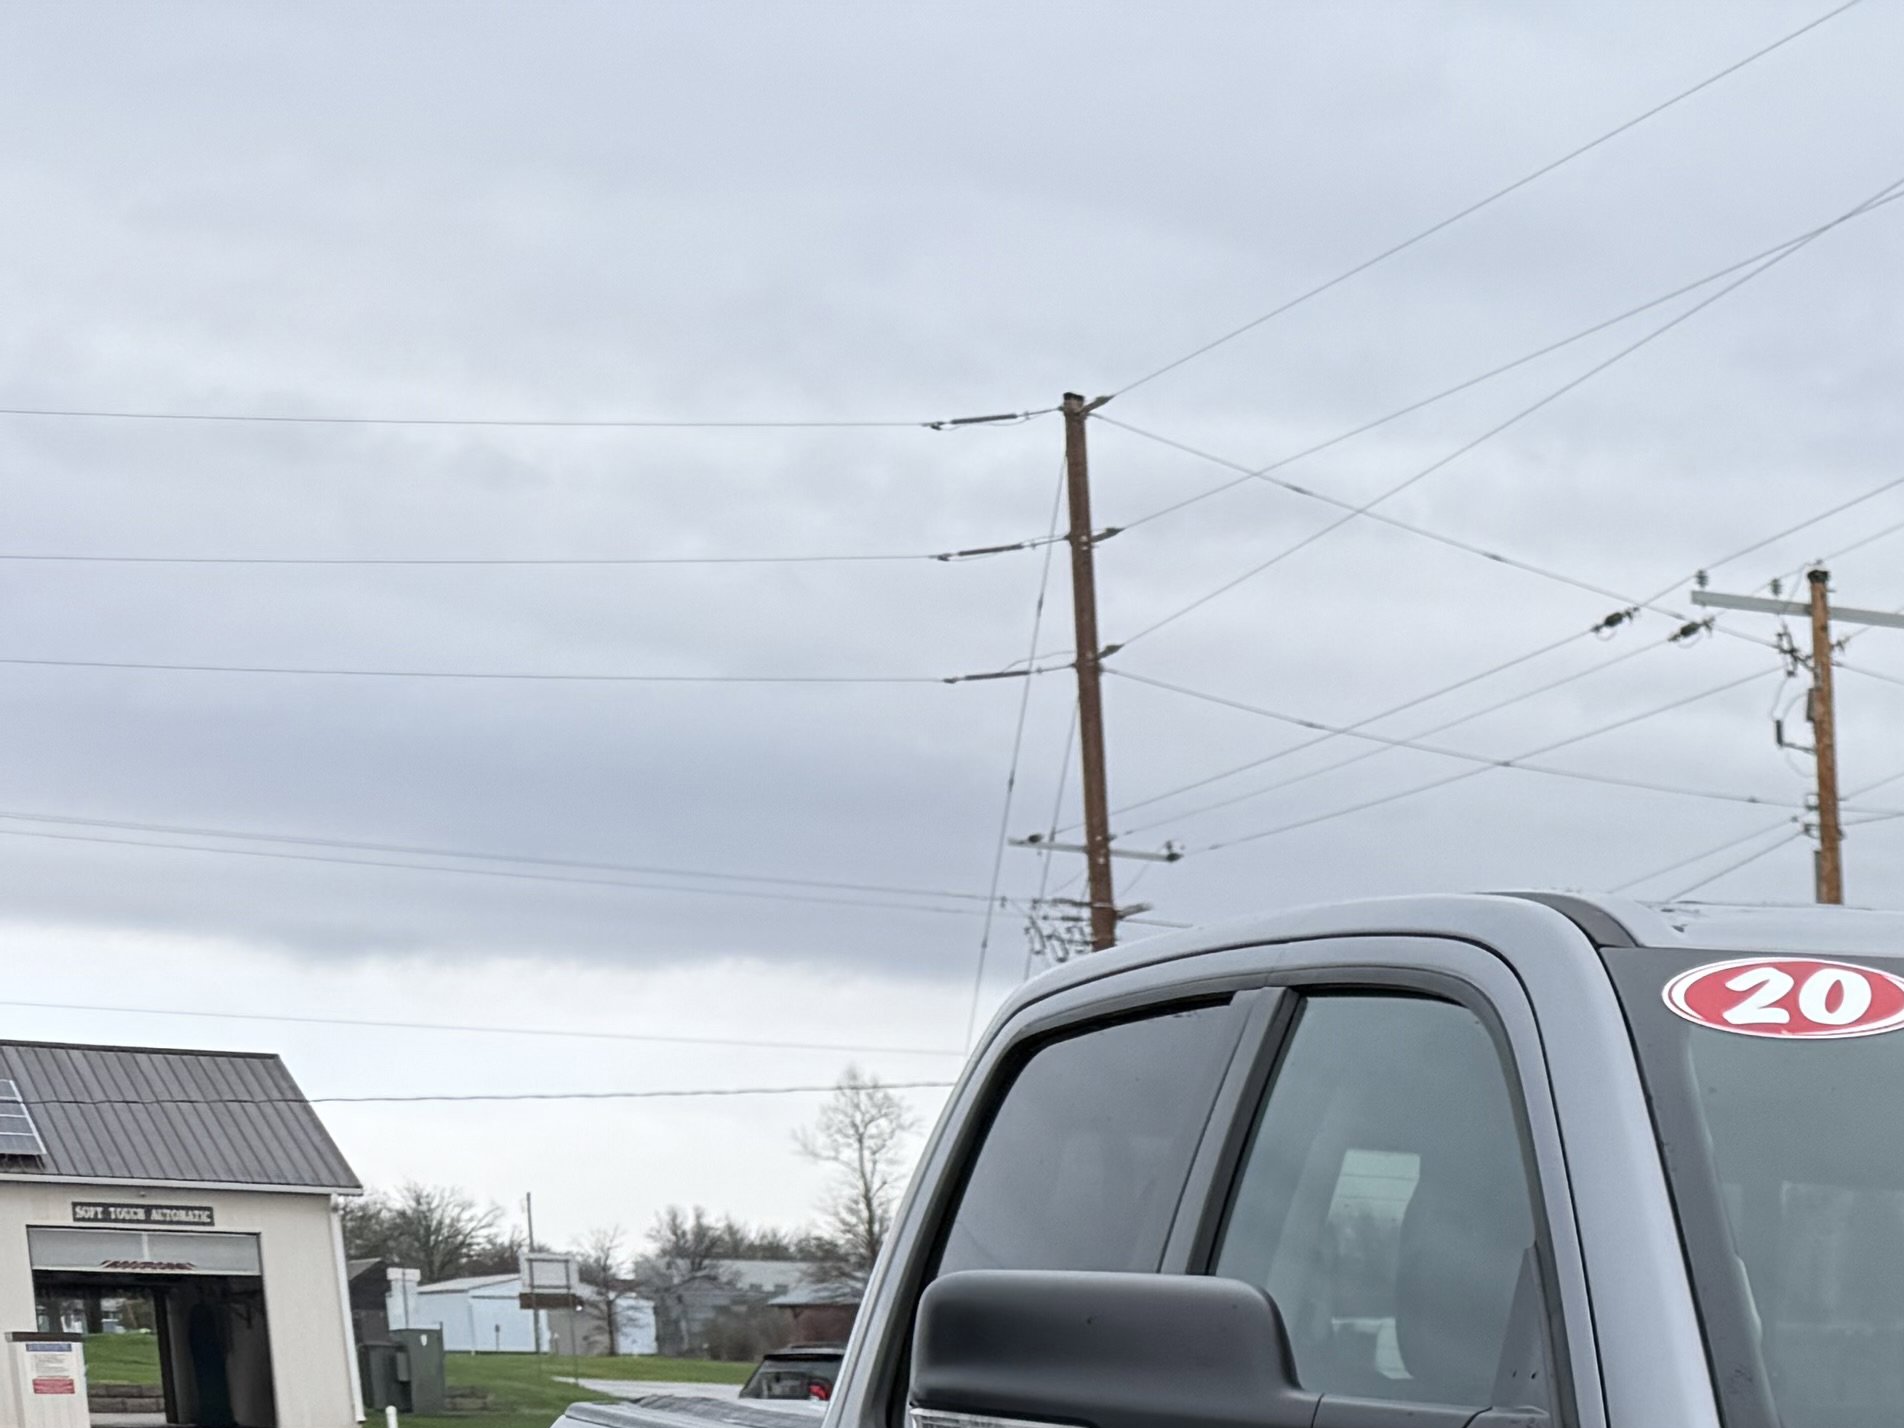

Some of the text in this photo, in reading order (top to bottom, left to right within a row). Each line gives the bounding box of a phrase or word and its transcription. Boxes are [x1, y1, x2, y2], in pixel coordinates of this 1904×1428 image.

[1722, 966, 1872, 1025] 20
[75, 1205, 211, 1223] SOFT TOUCH AUTOMATIC
